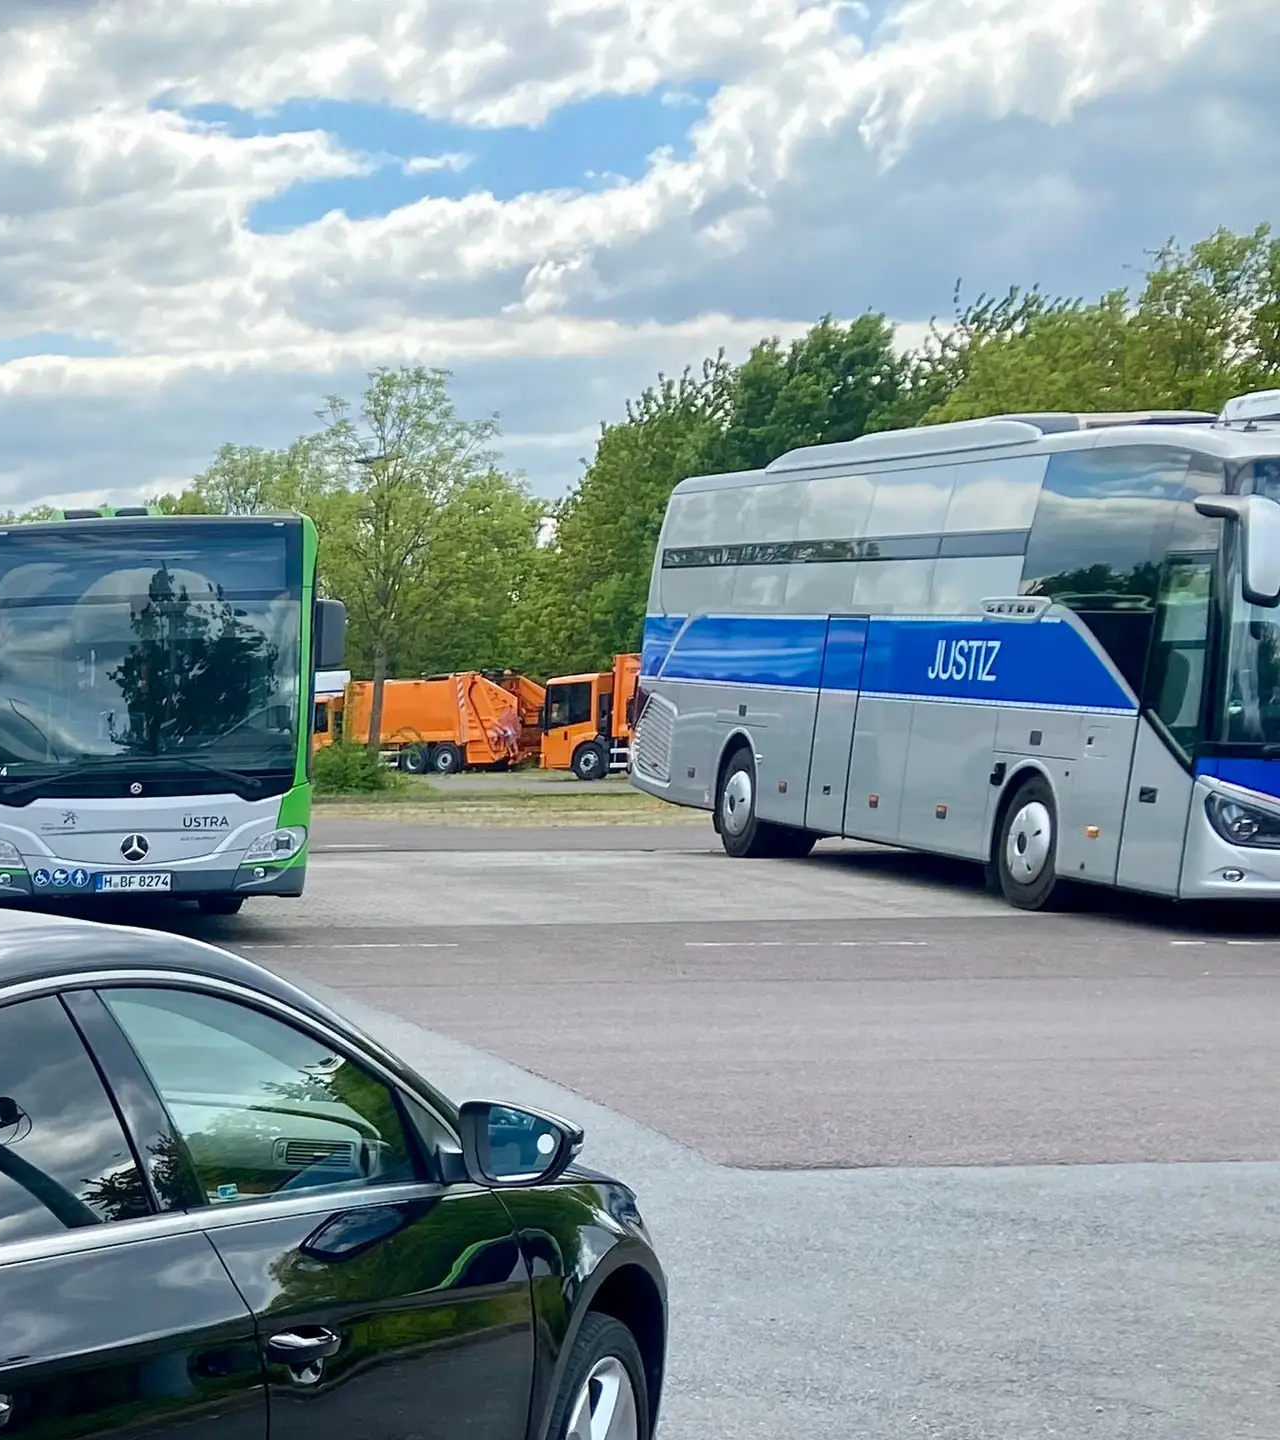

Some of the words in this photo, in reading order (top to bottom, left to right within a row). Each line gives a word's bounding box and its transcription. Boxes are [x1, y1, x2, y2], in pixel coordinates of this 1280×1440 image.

[986, 603, 1036, 613] SETRA
[927, 639, 1002, 682] JUSTIZ
[183, 812, 230, 828] ÜSTRA
[104, 876, 112, 888] H
[120, 875, 137, 888] BF
[138, 875, 170, 888] 8274
